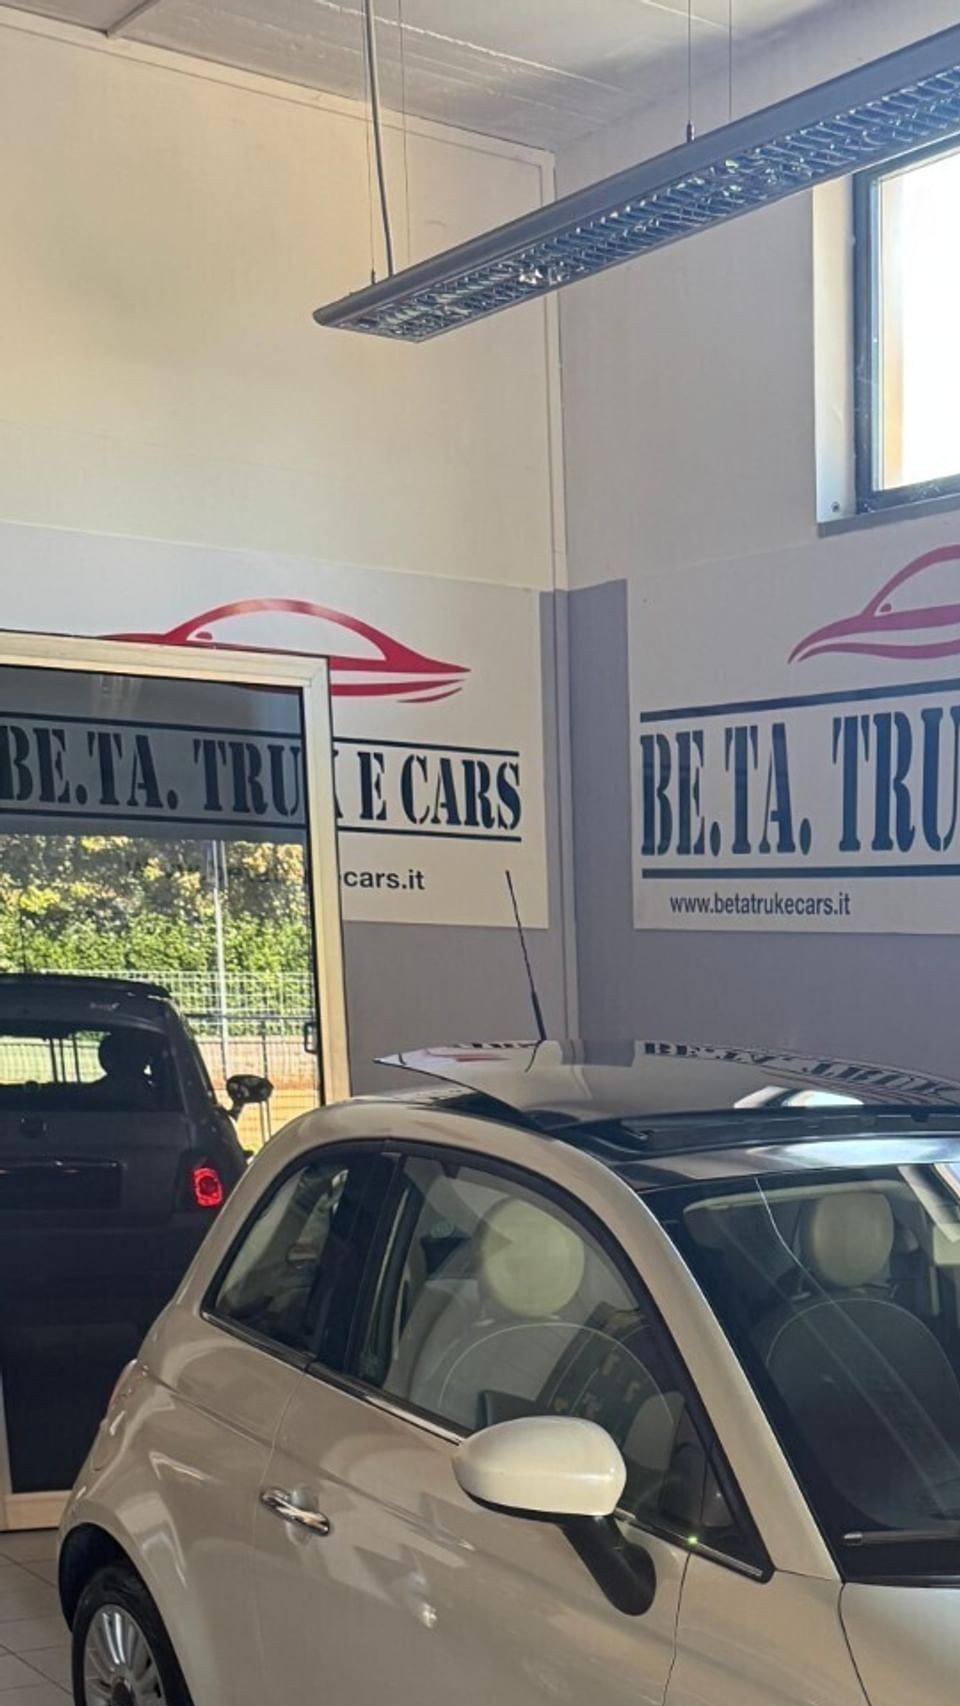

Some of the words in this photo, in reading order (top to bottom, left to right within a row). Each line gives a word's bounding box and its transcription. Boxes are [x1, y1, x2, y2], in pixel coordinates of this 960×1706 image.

[0, 725, 179, 810] BE.TA.
[357, 751, 387, 820] E
[401, 754, 522, 830] CARS
[640, 723, 812, 857] BE.TA.
[669, 892, 851, 916] www.betatrukecars.it
